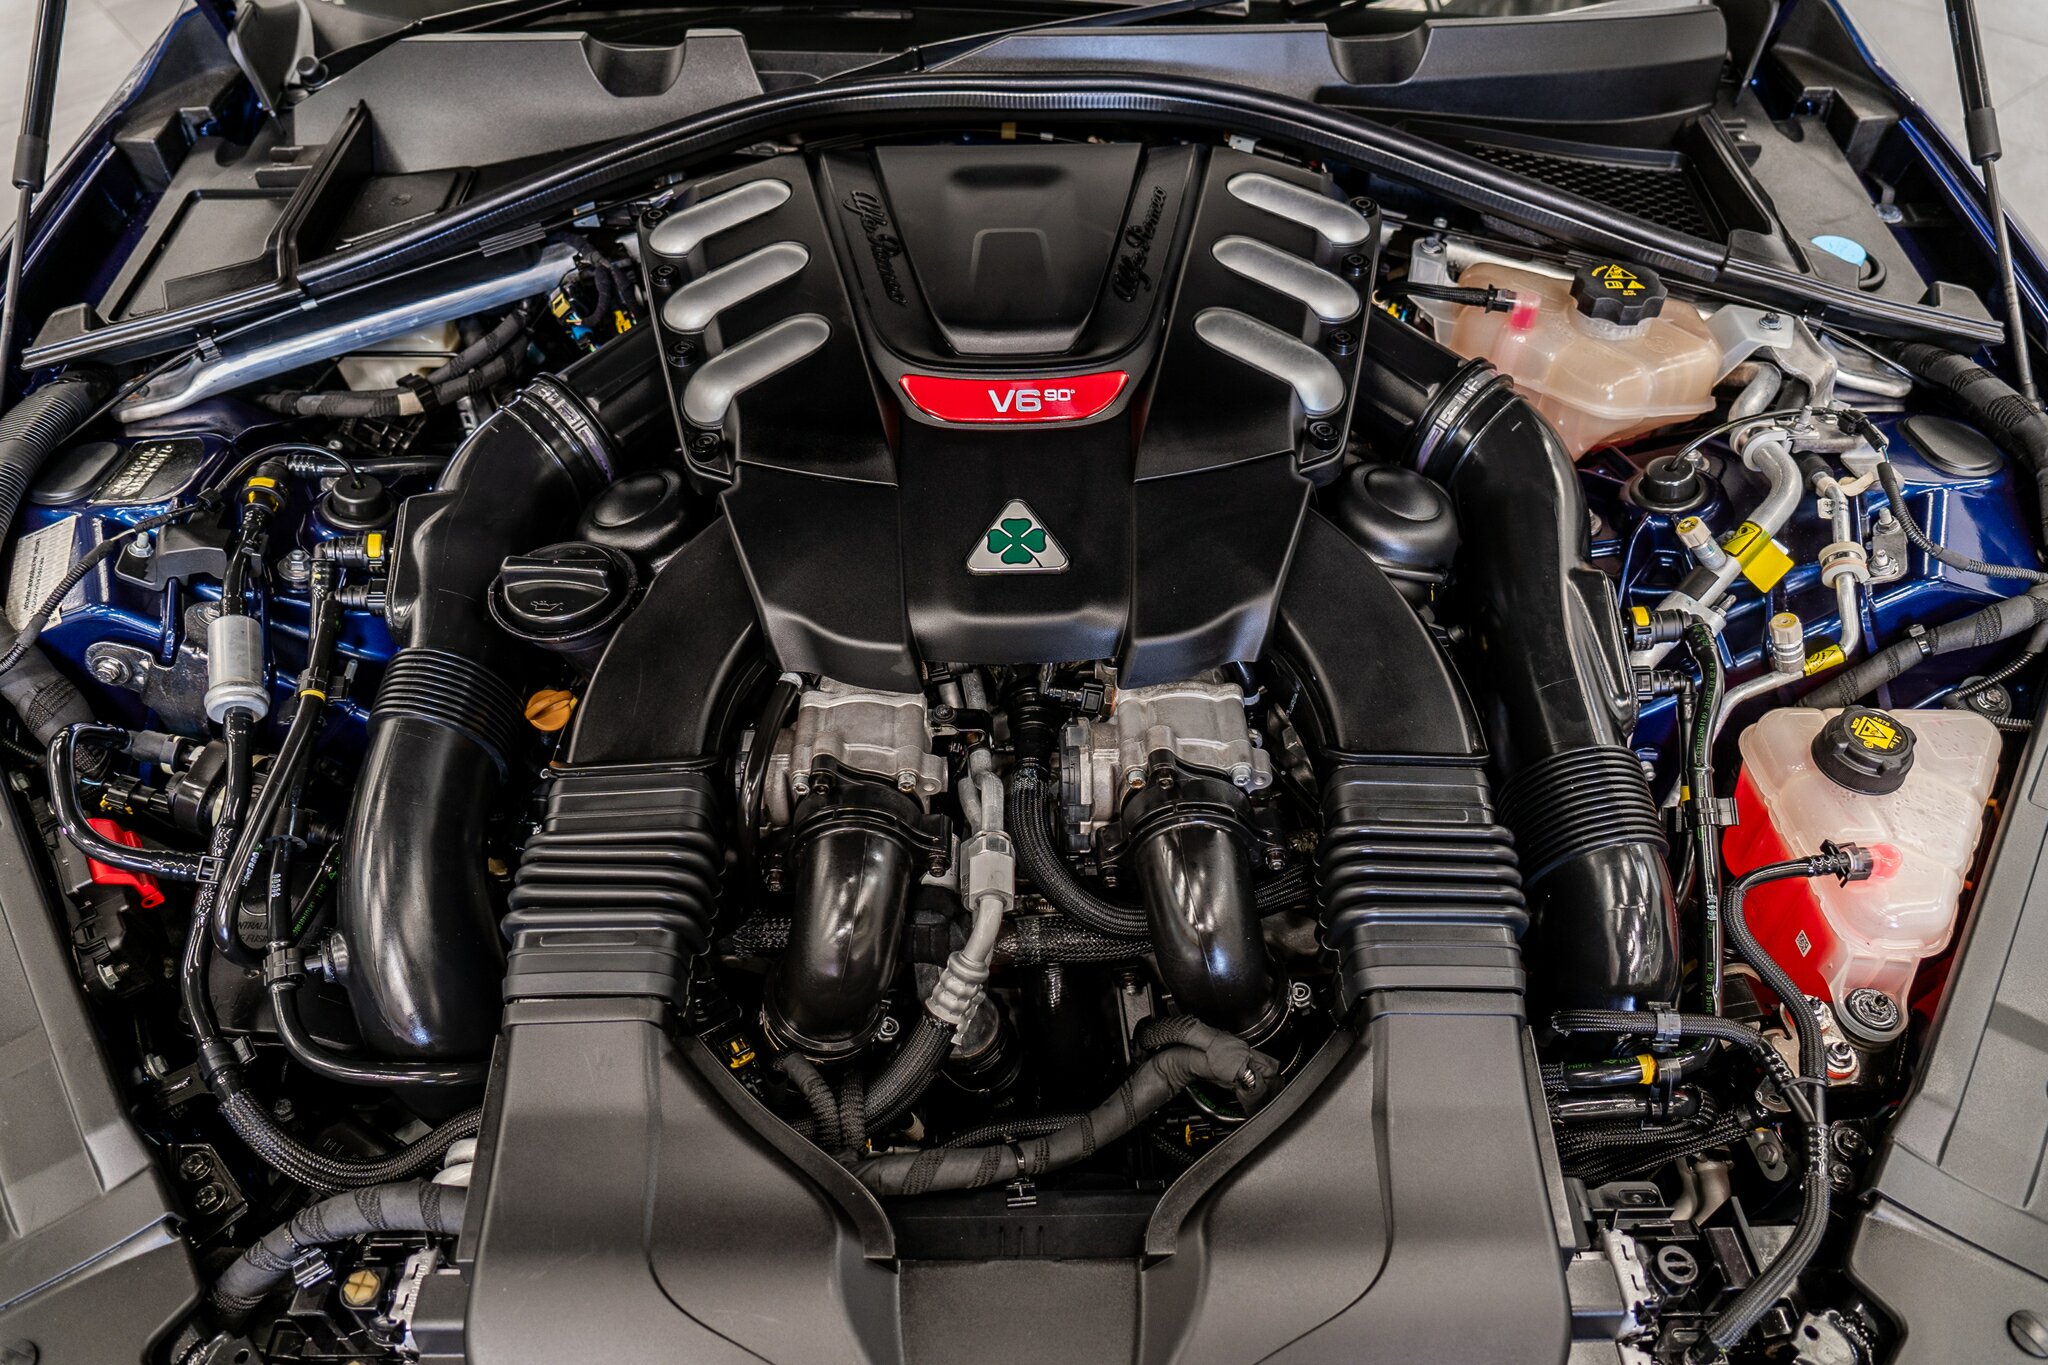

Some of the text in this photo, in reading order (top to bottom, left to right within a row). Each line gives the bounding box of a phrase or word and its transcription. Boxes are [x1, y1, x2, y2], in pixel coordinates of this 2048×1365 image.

[843, 190, 908, 307] Alfa Romeo
[1112, 184, 1167, 303] Alfa Romeo
[988, 389, 1042, 413] V6
